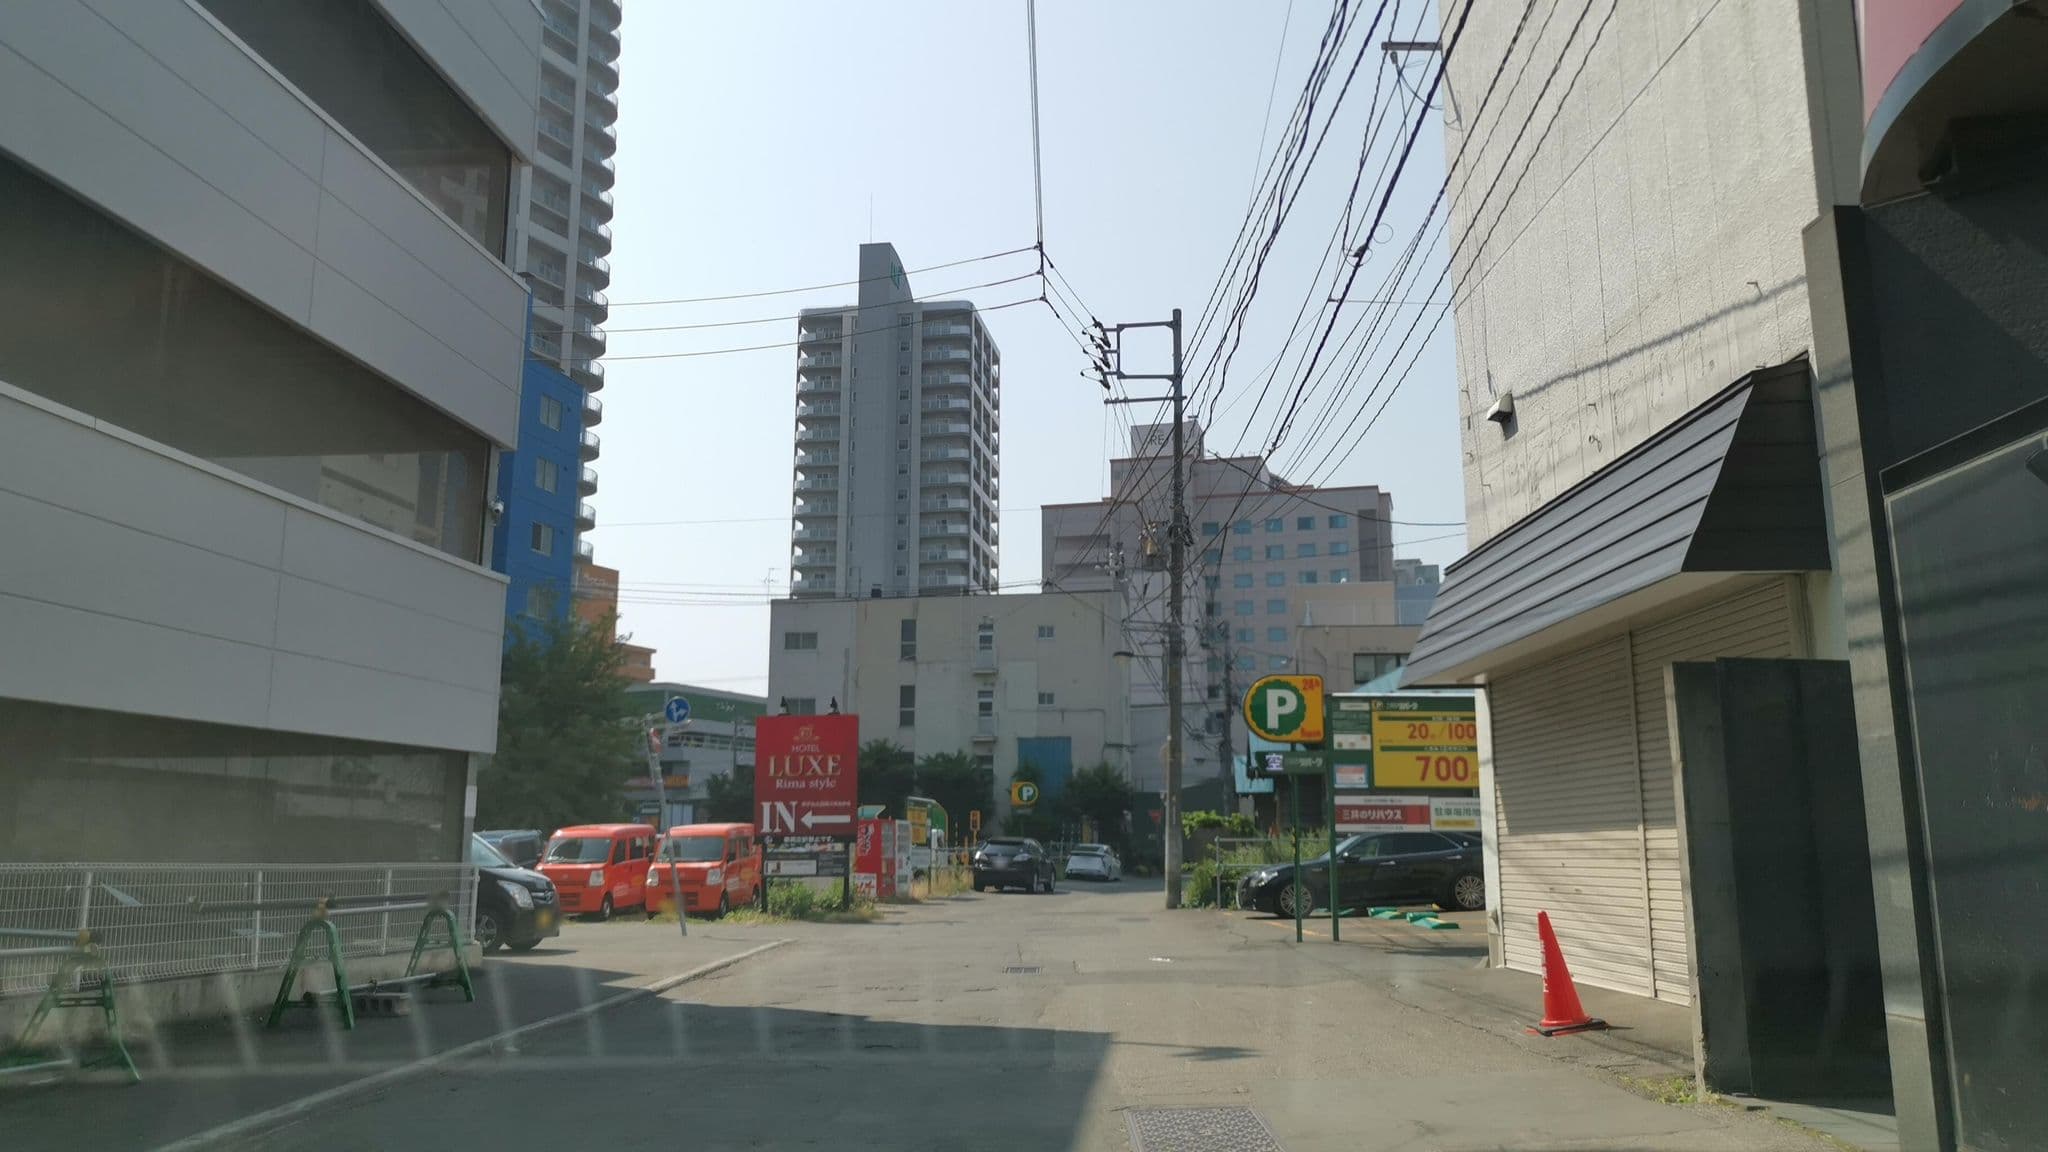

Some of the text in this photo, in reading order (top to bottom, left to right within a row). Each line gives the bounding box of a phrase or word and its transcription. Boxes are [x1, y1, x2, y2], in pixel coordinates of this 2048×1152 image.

[1266, 689, 1298, 729] P
[1408, 723, 1429, 740] 20
[792, 744, 820, 752] HOTEL
[769, 755, 841, 777] LUXE
[1265, 753, 1284, 771] 空
[1416, 756, 1469, 782] 700
[776, 778, 837, 790] Rima style
[1022, 785, 1034, 800] P
[760, 801, 797, 833] IN
[1343, 809, 1402, 821] 三井のリハウス
